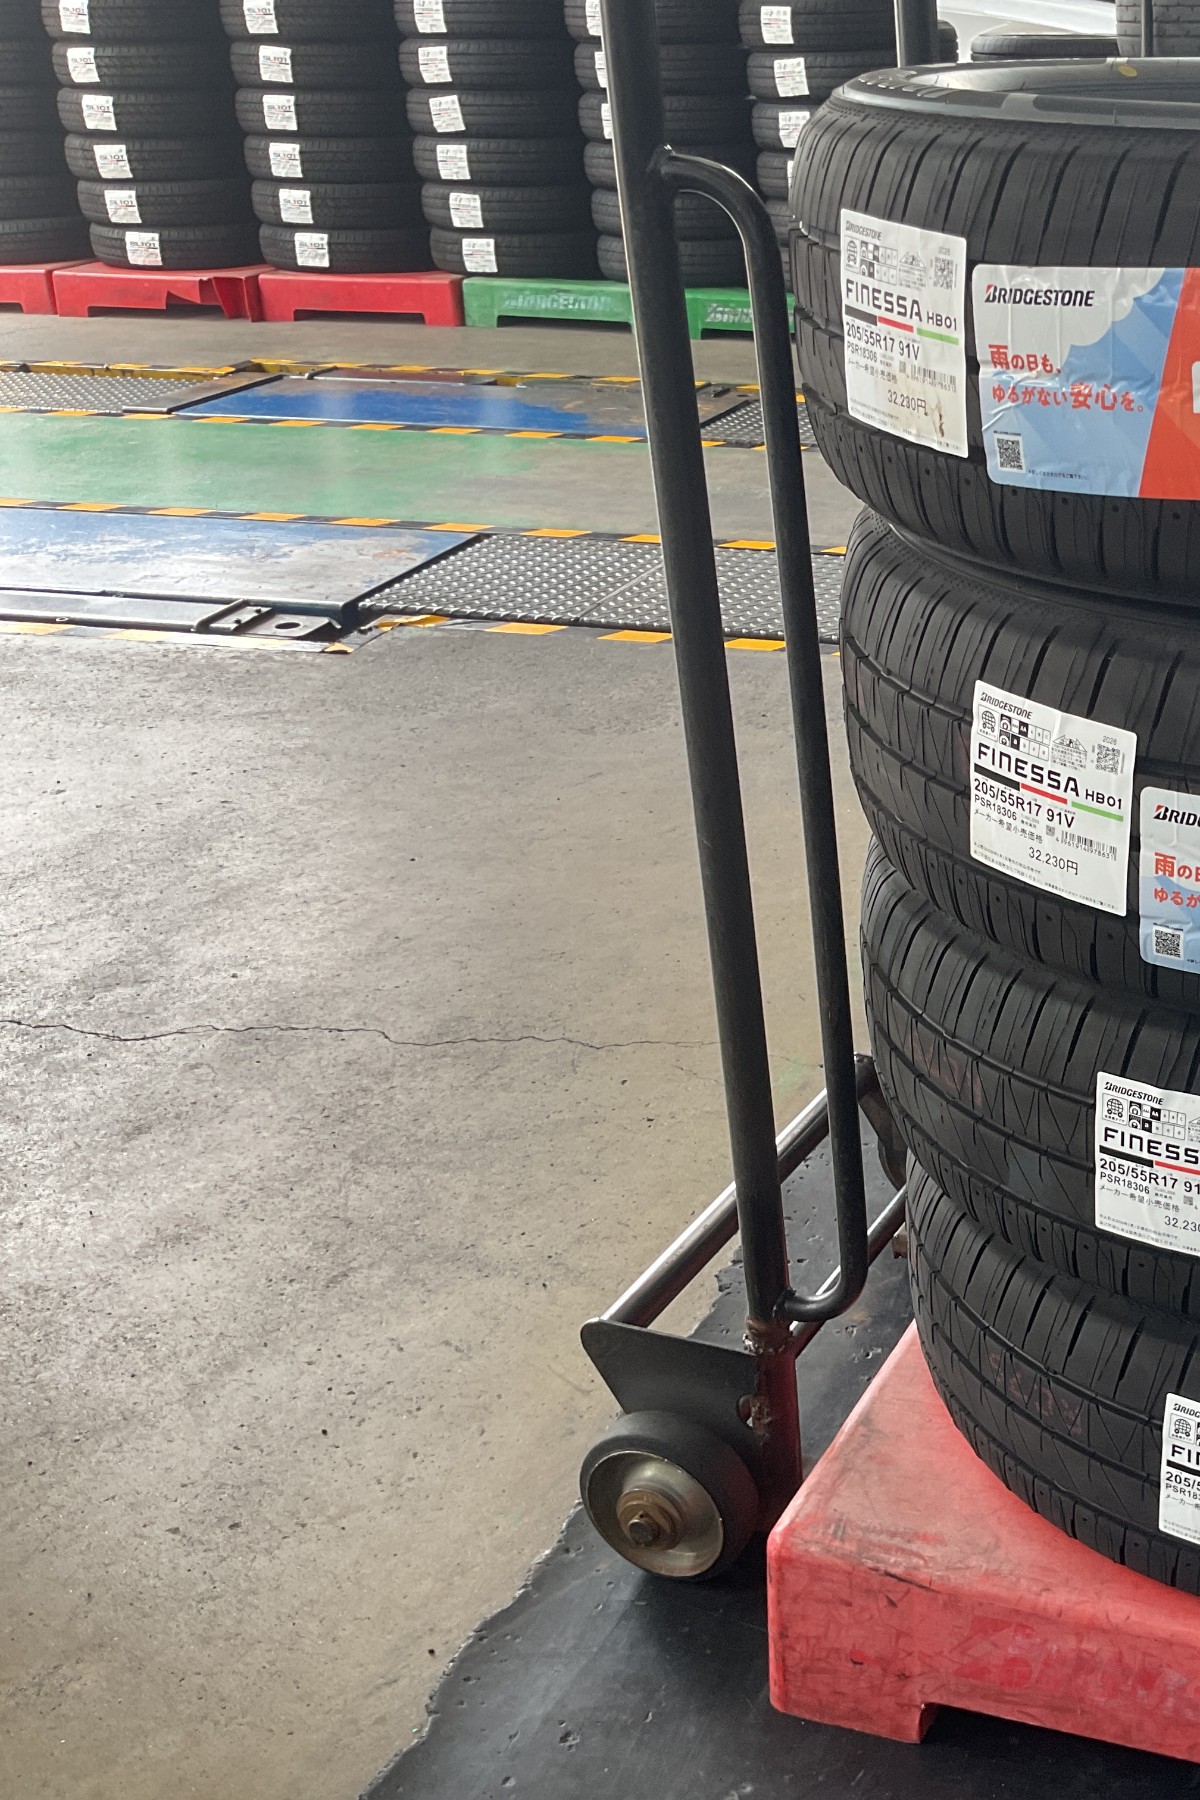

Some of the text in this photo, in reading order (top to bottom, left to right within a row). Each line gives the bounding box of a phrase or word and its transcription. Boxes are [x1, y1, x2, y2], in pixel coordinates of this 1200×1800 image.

[846, 278, 958, 331] FINESSA HB01
[985, 284, 1095, 307] BRIDGESTONE
[846, 321, 920, 361] 205/55R17 91V
[847, 343, 878, 363] PSR18306
[848, 359, 898, 385] メーカー希望小売価格
[988, 344, 1061, 374] 雨の日も、
[992, 382, 1144, 412] ゆるがない安心を。
[980, 692, 1033, 720] BRIDGESTONE
[978, 742, 1080, 797] FINESSA
[1085, 788, 1122, 810] HB01
[974, 778, 1042, 817] 205/55R17
[1046, 808, 1075, 828] 91V
[974, 794, 1017, 821] PSR18306
[974, 809, 1043, 844] メーカー希望小売価格
[1104, 1081, 1165, 1106] BRIDGESTONE
[1100, 1158, 1178, 1190] 205/55R17
[1100, 1172, 1150, 1195] PSR18306
[1100, 1184, 1180, 1213] メーカー希望小売価格
